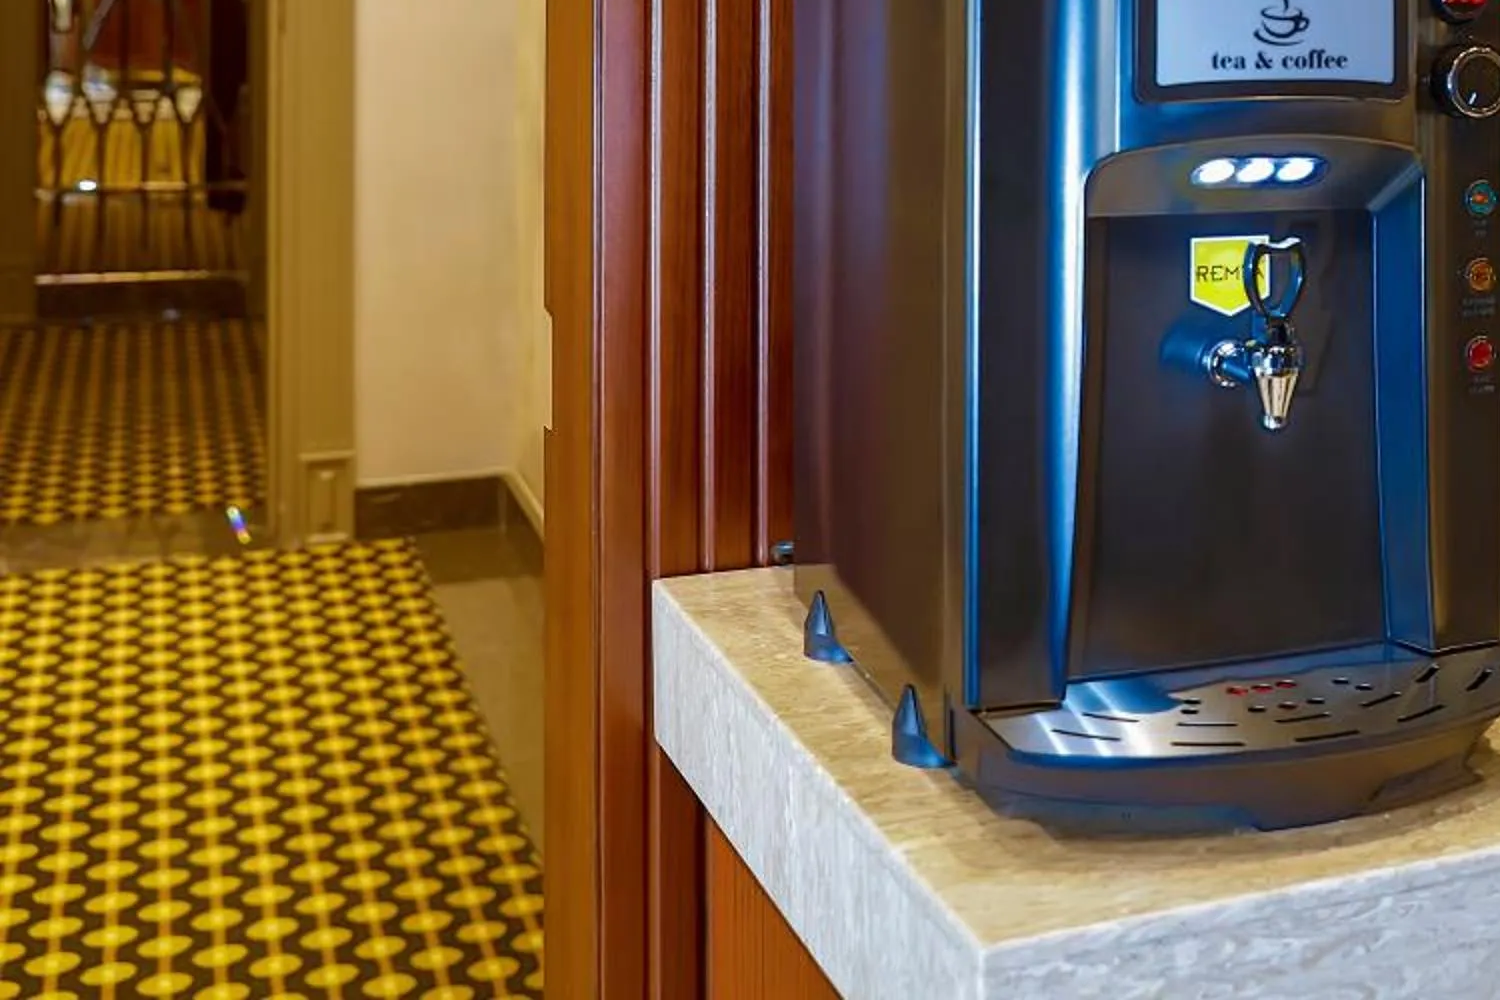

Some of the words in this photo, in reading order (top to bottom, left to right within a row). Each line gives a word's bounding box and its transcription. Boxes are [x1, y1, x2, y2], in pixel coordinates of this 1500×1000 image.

[1211, 51, 1246, 70] tea
[1254, 50, 1273, 70] &
[1281, 48, 1349, 70] coffee
[1196, 264, 1265, 282] REMA
